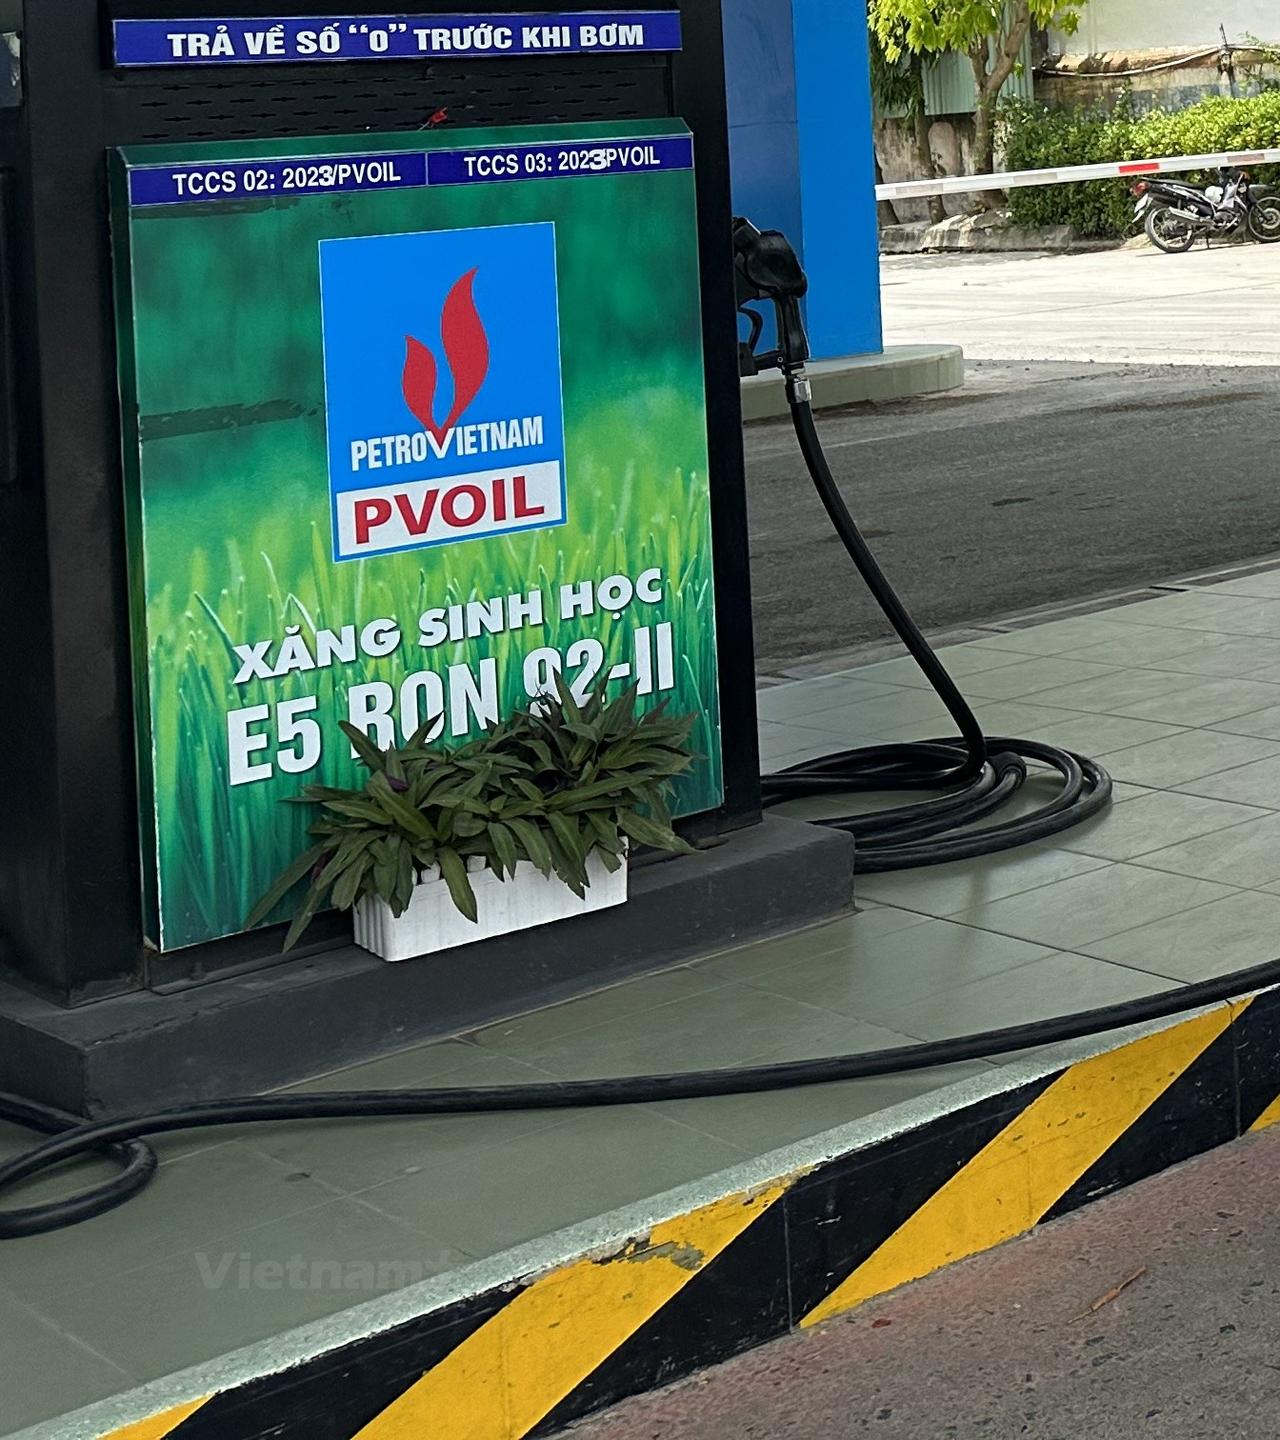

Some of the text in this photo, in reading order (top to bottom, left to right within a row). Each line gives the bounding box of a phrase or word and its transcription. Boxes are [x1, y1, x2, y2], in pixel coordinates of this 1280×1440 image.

[167, 25, 235, 56] TRẢ
[244, 23, 286, 55] VỀ
[296, 22, 340, 54] SỐ
[413, 24, 512, 52] TRƯỚC
[522, 27, 571, 48] KHI
[580, 24, 645, 47] BƠM
[172, 171, 237, 195] TCCS
[243, 169, 276, 191] 02:
[463, 154, 519, 177] TCCS
[524, 153, 552, 173] 03:
[350, 416, 545, 472] PETROVIETNAM
[353, 475, 546, 545] PVOIL
[232, 567, 663, 685] XĂNG SINH HỌC
[226, 695, 321, 787] E5
[347, 657, 500, 759] RON
